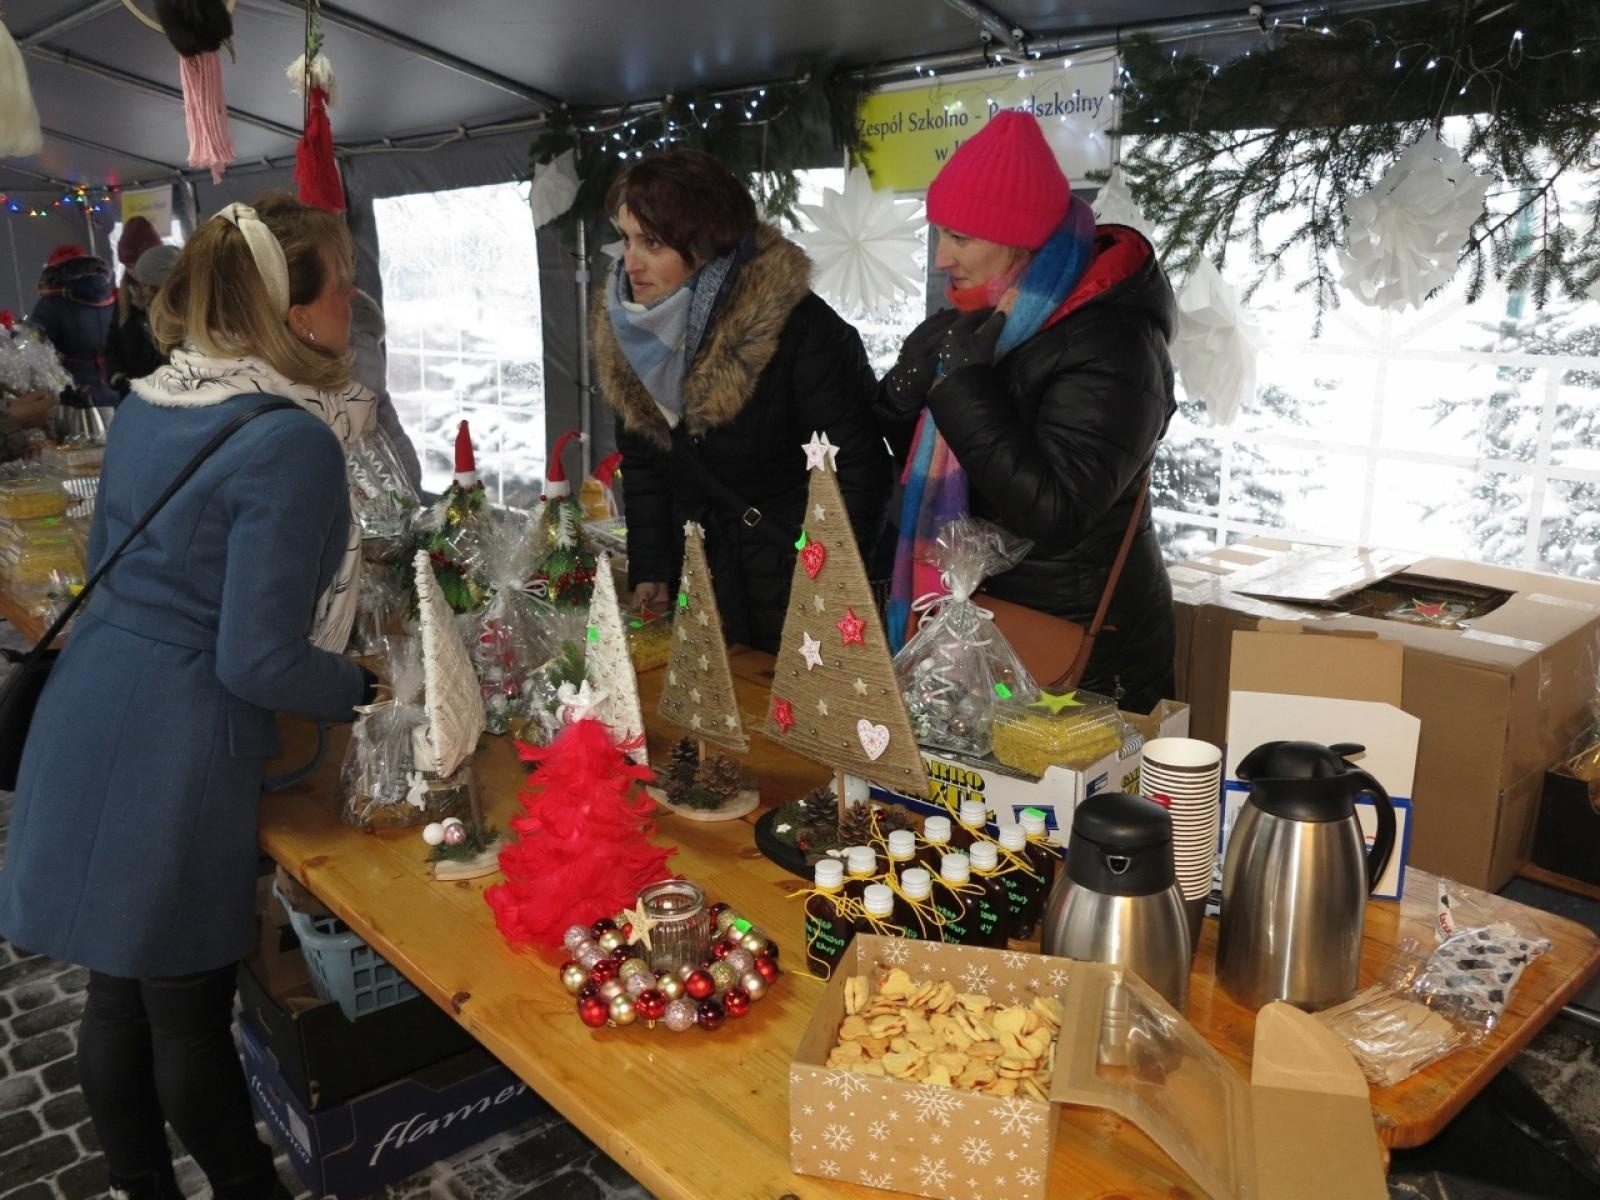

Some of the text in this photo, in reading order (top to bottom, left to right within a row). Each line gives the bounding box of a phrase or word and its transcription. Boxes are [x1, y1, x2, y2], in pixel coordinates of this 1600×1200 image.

[858, 112, 903, 141] Zespół
[908, 108, 968, 132] Szkolno
[935, 148, 948, 161] w
